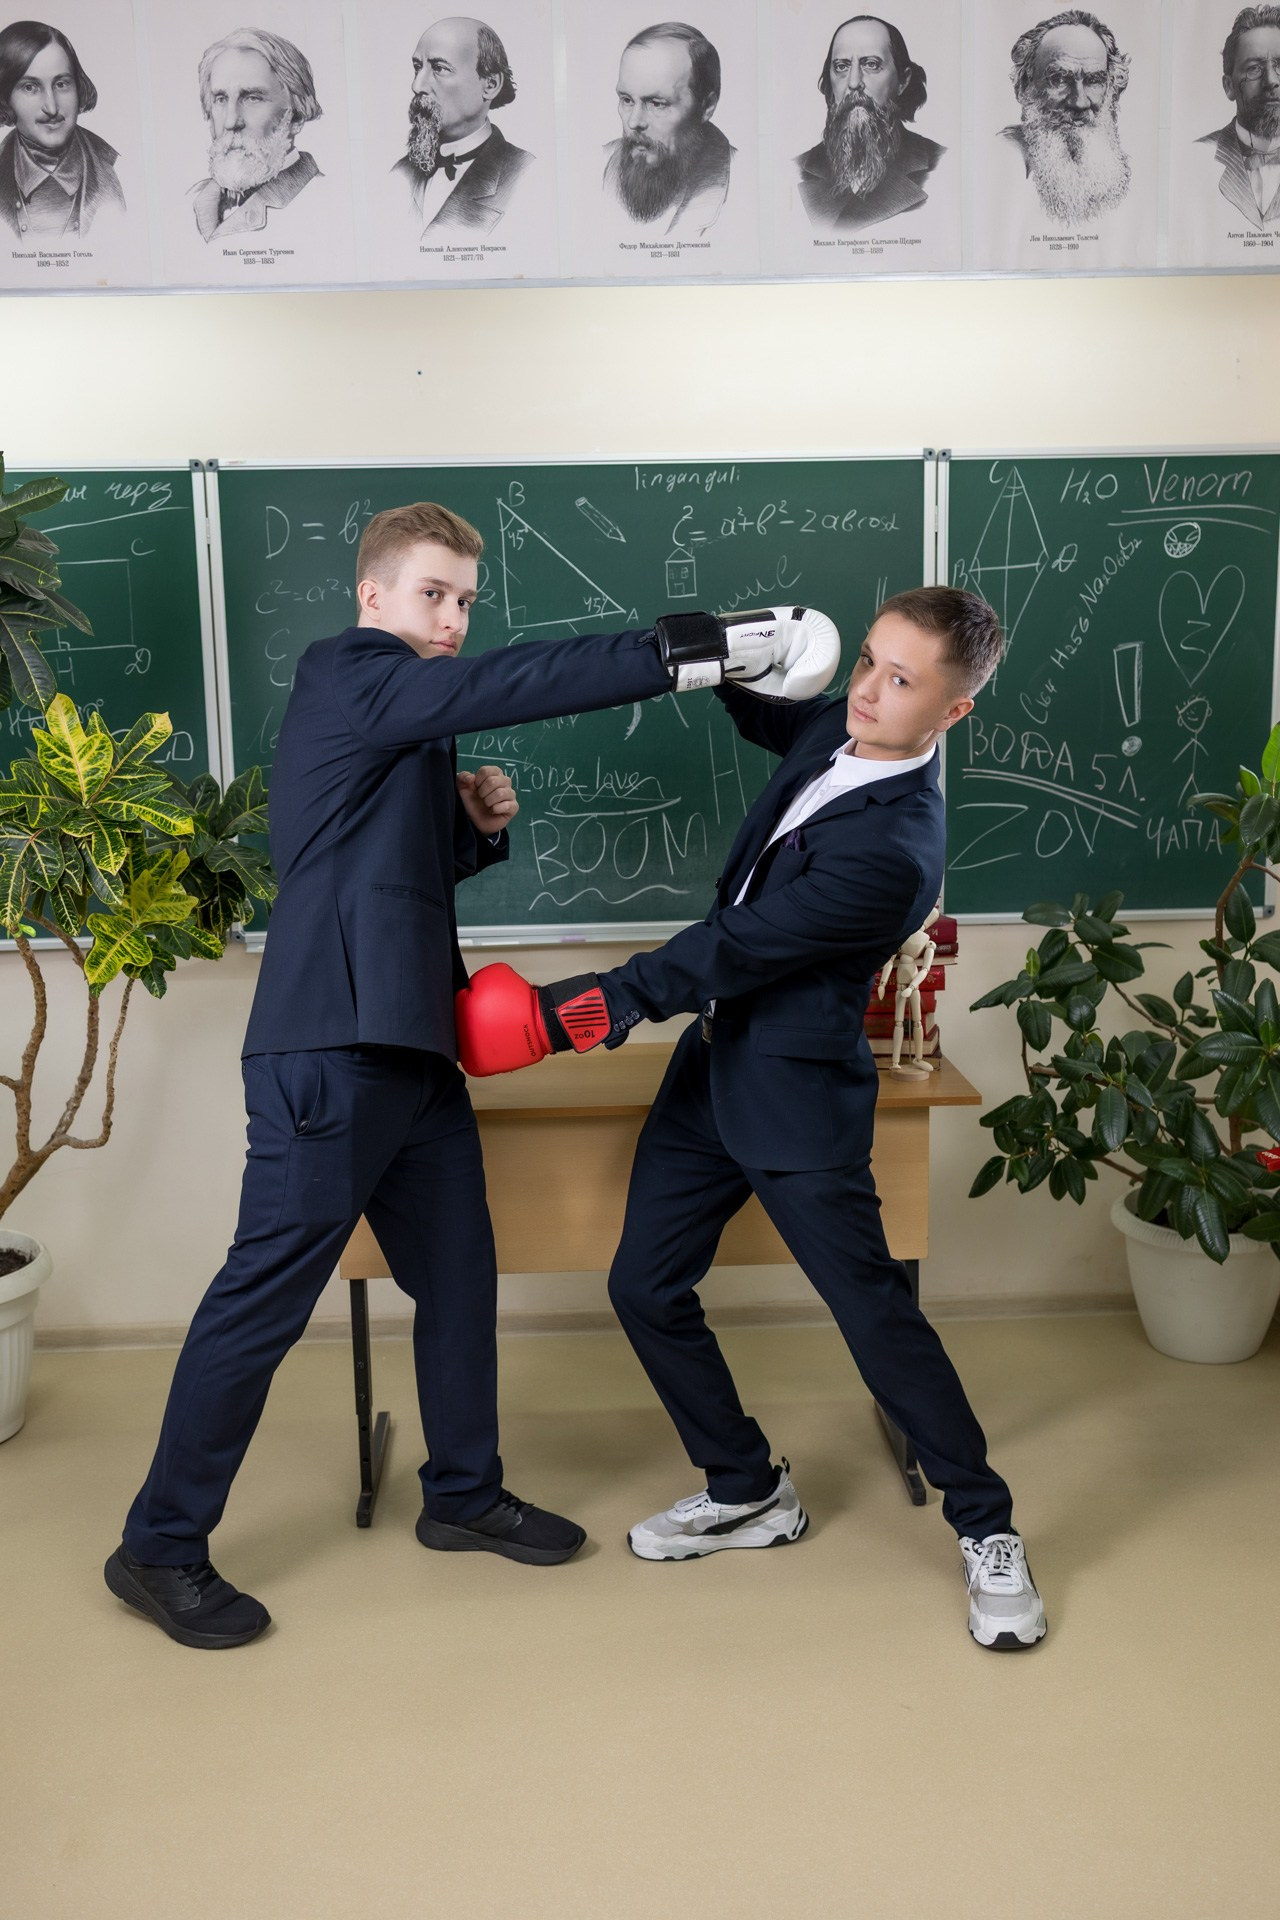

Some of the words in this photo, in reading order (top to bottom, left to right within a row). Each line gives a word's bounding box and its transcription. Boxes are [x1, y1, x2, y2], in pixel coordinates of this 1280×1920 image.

[1029, 234, 1041, 242] Лев
[1042, 234, 1075, 242] Николаевич
[1076, 233, 1099, 241] Толстой
[1227, 231, 1245, 239] Антон
[619, 242, 637, 250] Федор
[676, 241, 711, 249] Достоевский
[813, 239, 836, 247] Михаил
[239, 248, 267, 256] Сергеевич
[269, 248, 294, 256] Тургенев
[480, 244, 506, 252] Некрасов
[12, 251, 37, 259] Николай
[39, 251, 71, 259] Васильевич
[1143, 458, 1253, 504] Venom
[528, 811, 708, 888] BOOM
[523, 1024, 537, 1057] OUTSHOCK
